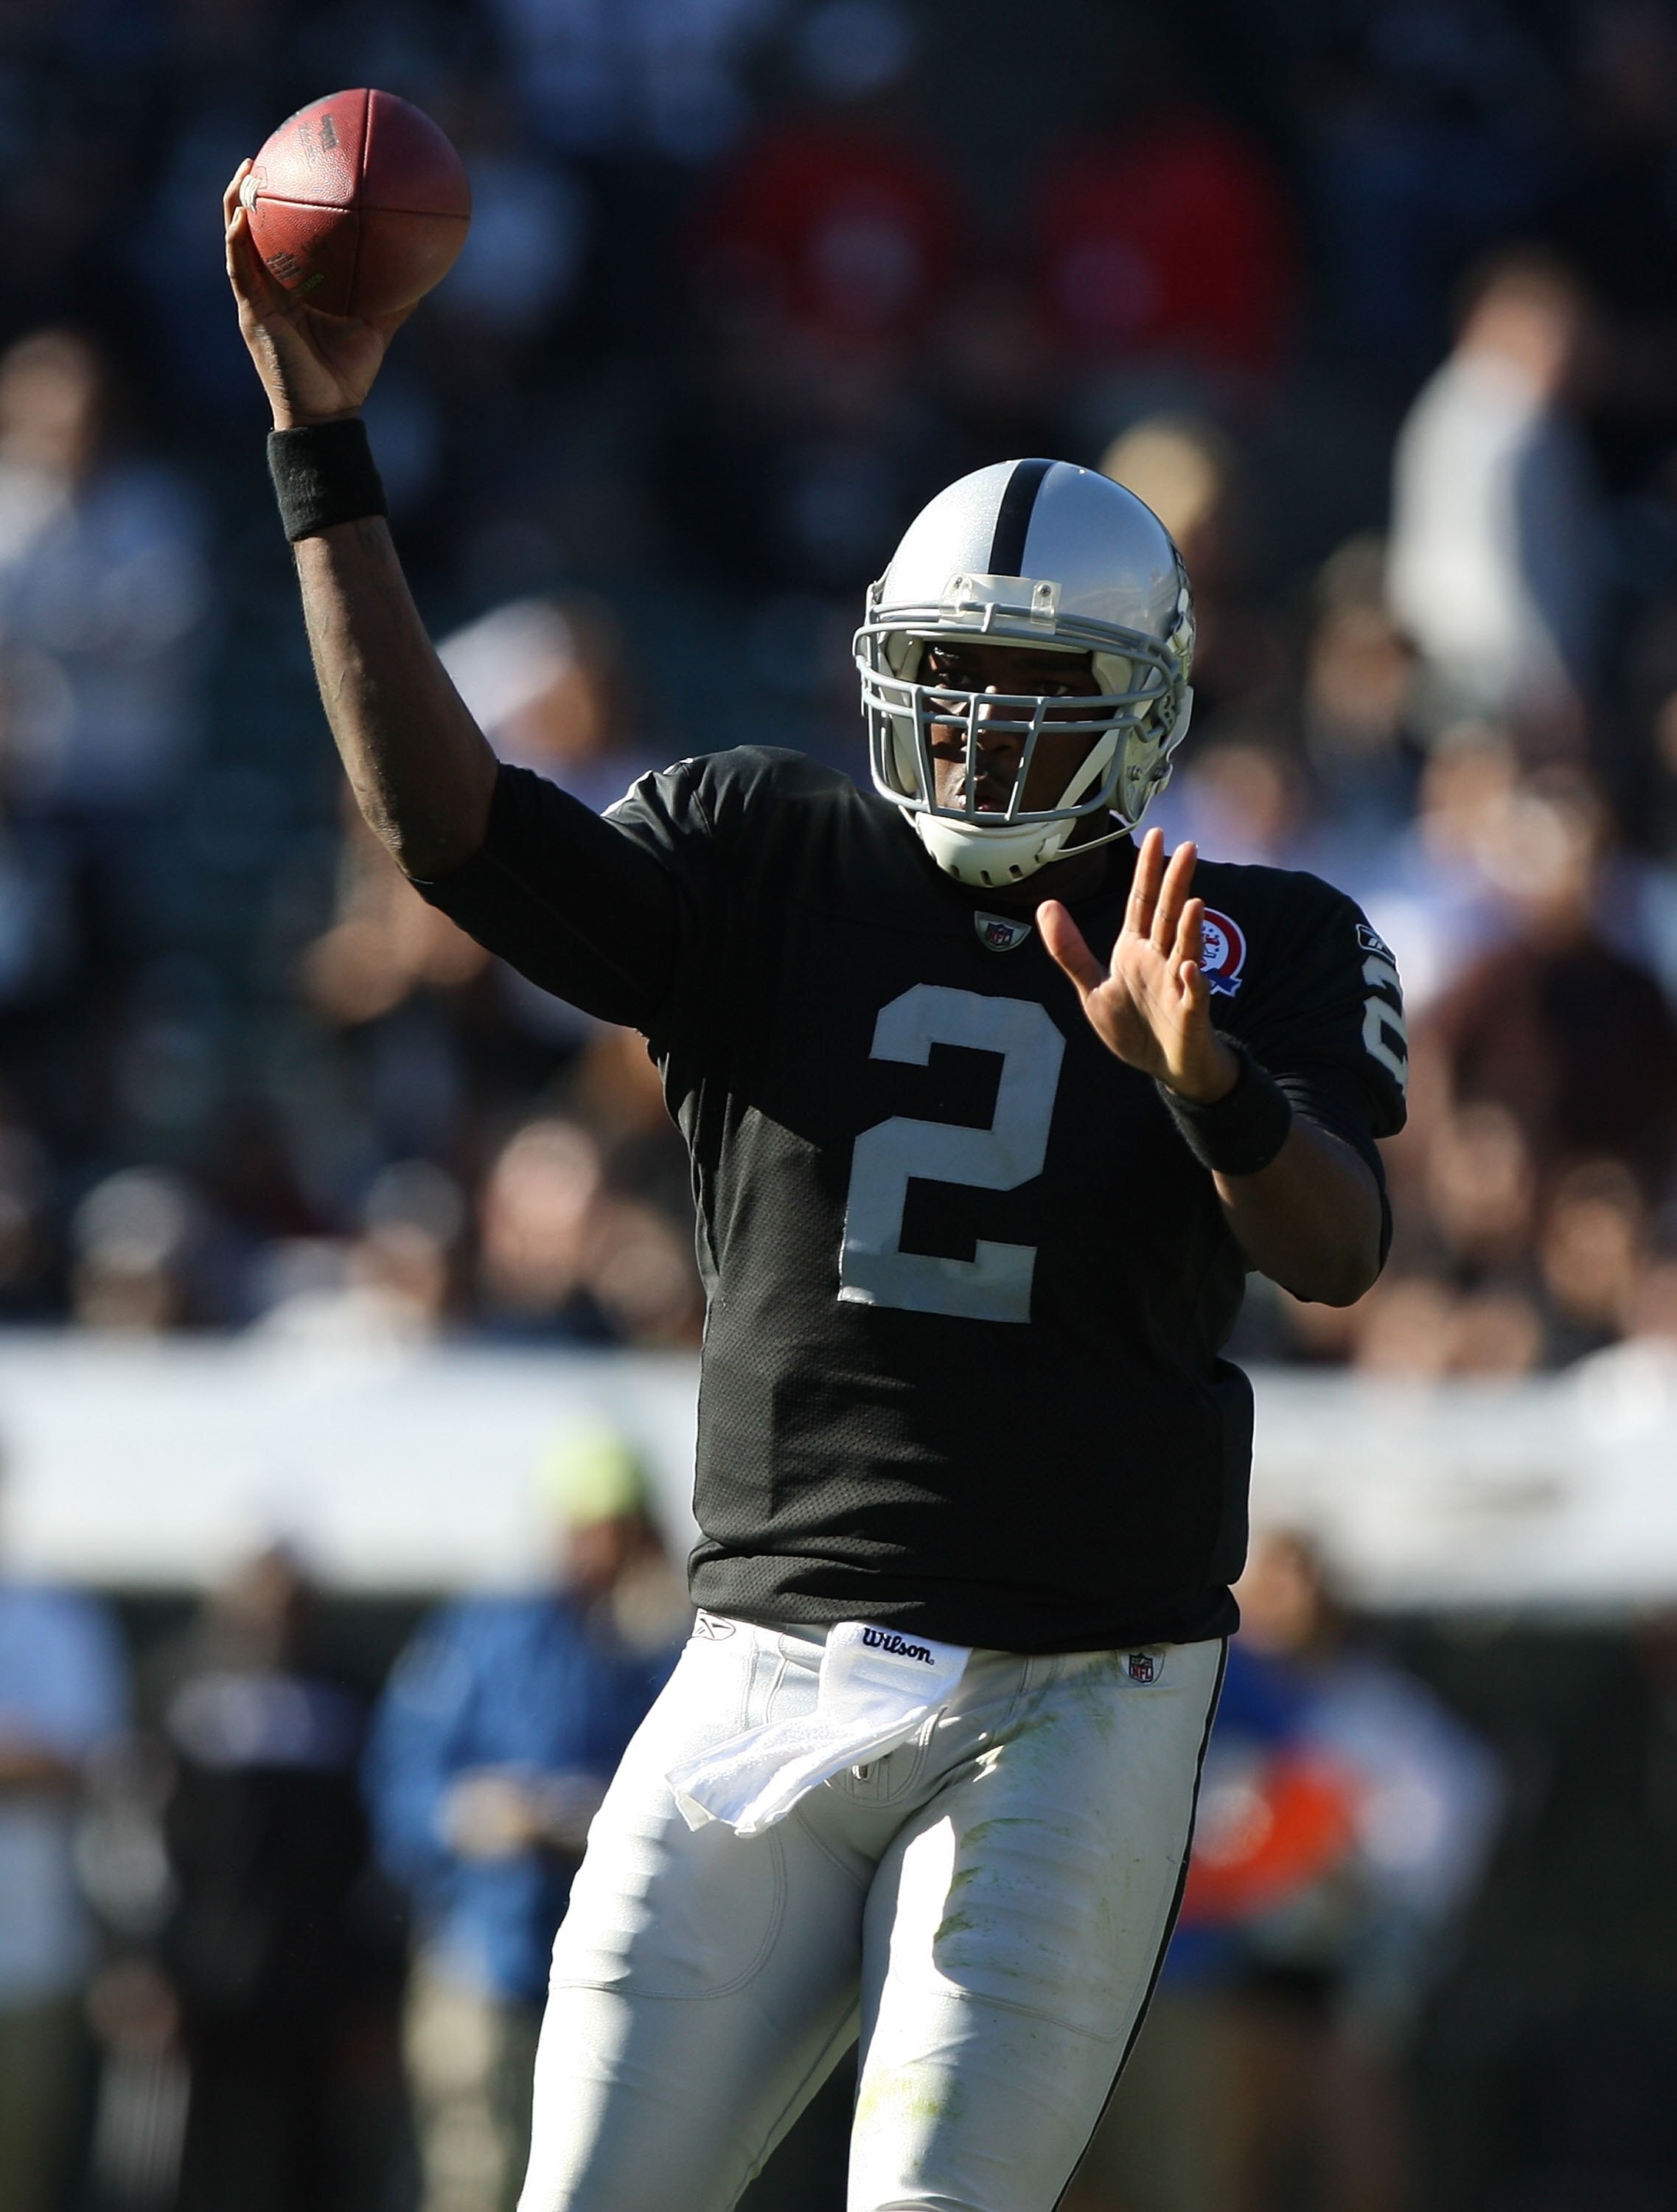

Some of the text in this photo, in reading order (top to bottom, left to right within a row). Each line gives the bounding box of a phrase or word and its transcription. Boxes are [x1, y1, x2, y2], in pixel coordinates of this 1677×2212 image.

[1362, 954, 1408, 1099] 2
[837, 983, 1067, 1324] 2
[862, 1627, 932, 1665] Wilson
[1132, 1663, 1152, 1680] NFL
